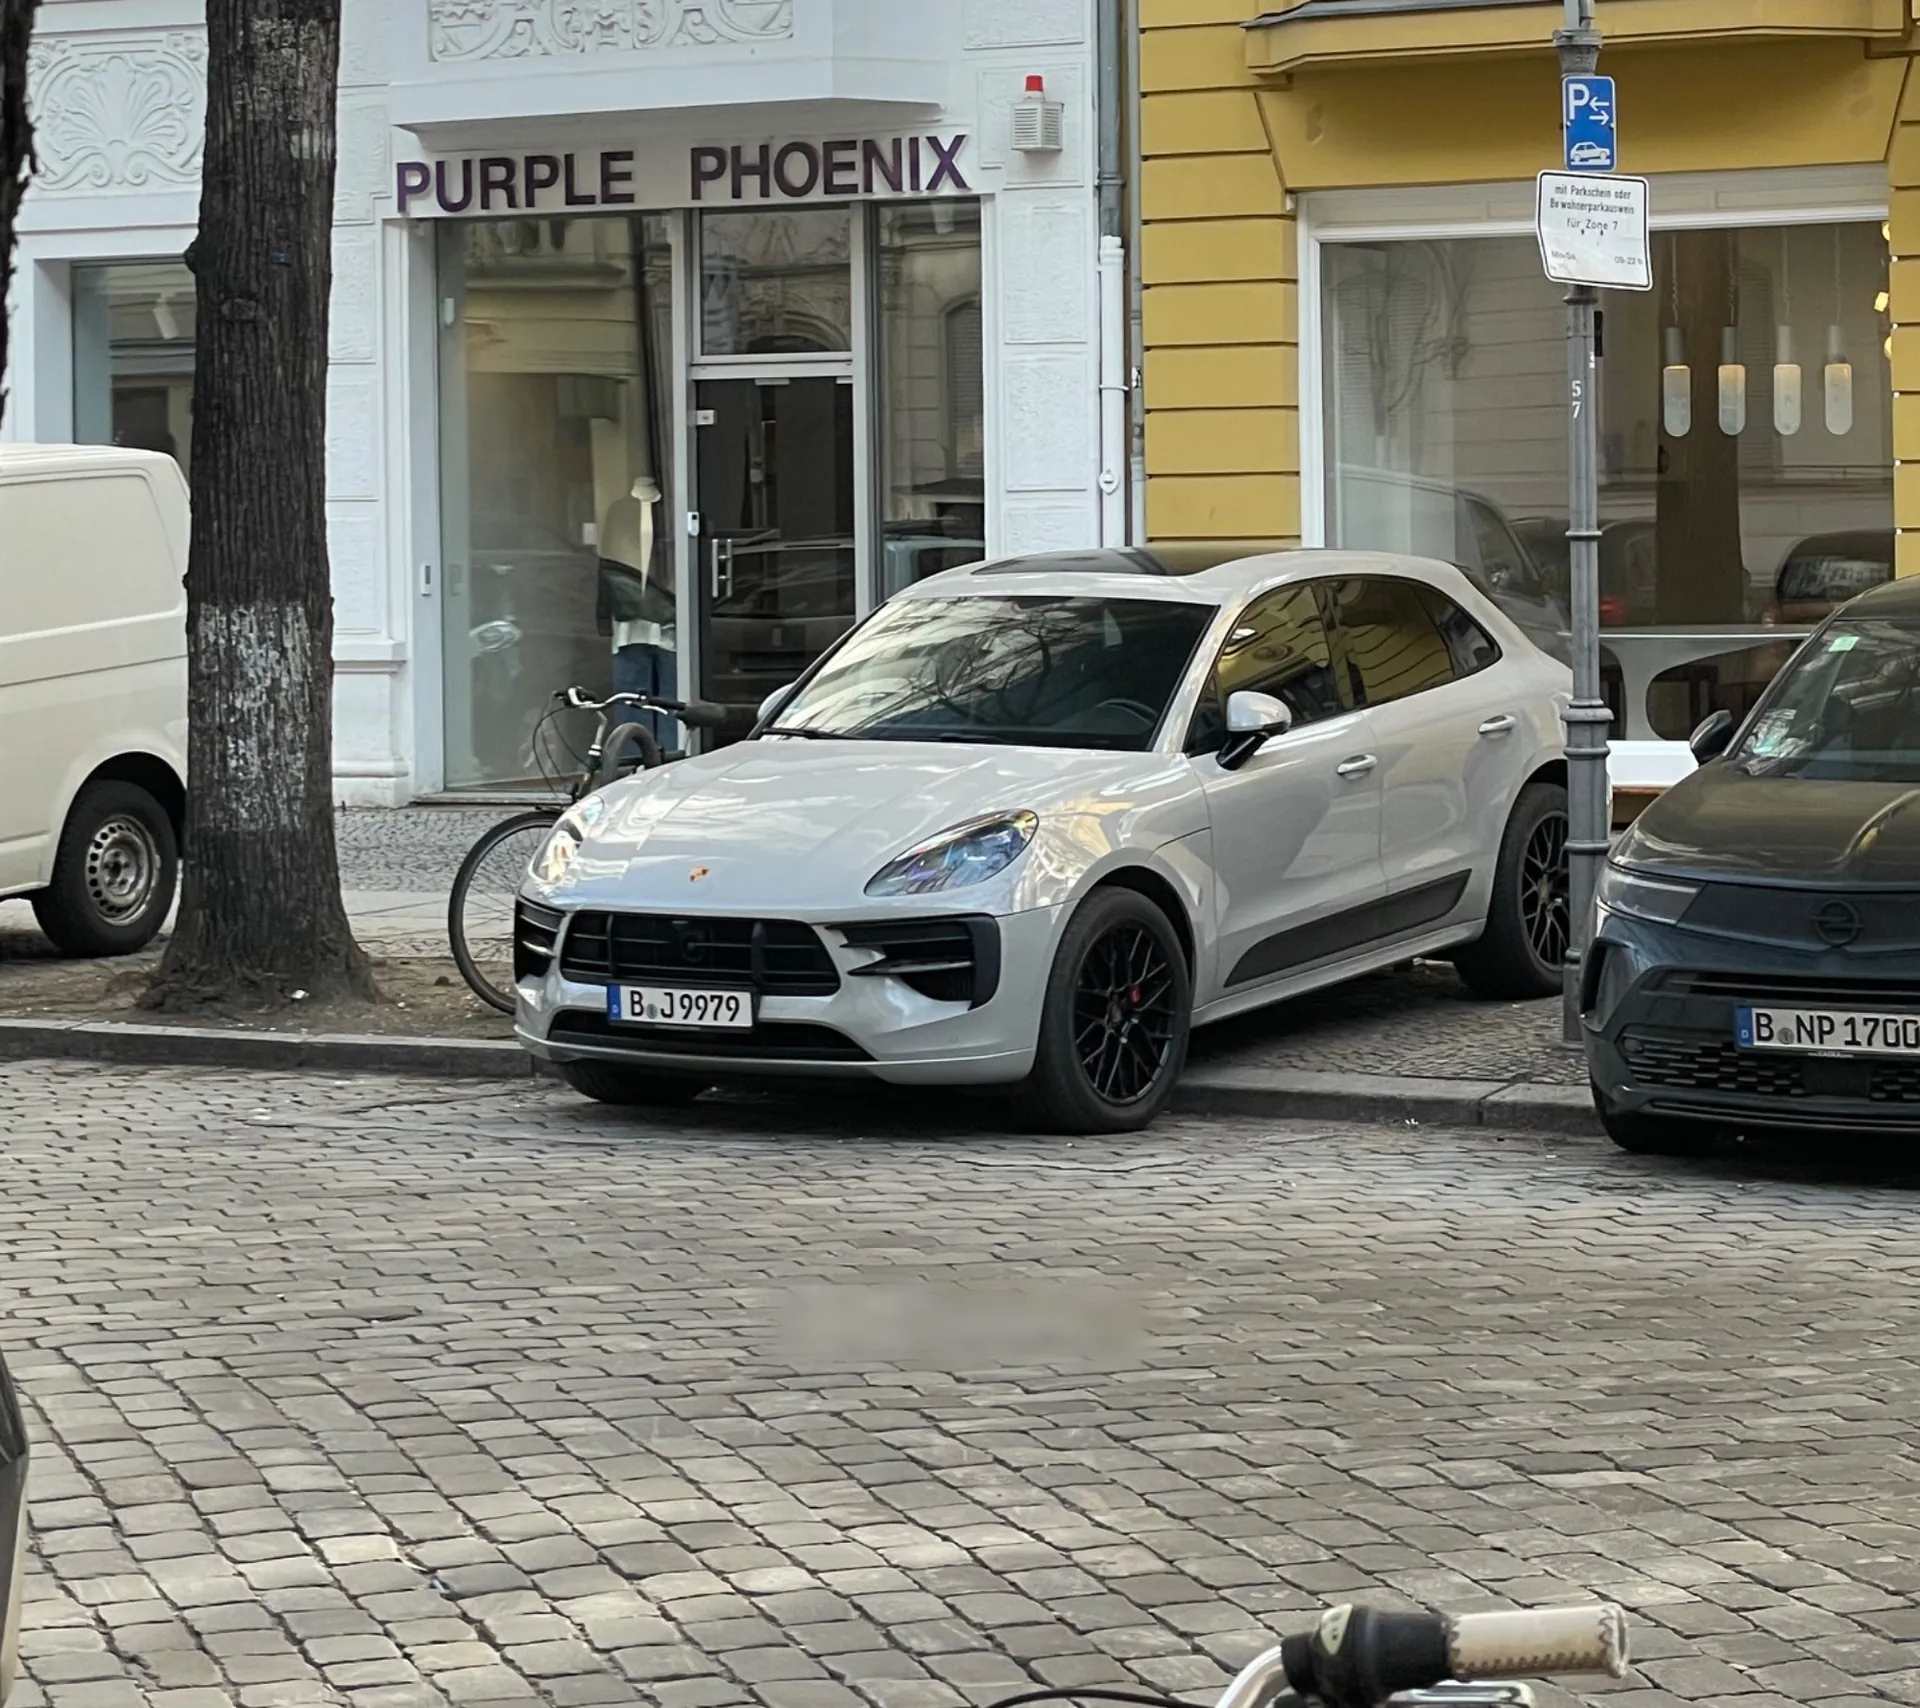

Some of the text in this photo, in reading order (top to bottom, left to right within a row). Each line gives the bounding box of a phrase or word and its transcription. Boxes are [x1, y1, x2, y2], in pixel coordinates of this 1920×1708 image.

[1568, 83, 1590, 120] P
[396, 134, 970, 216] PURPLE PHOENIX
[1555, 185, 1632, 200] mit Parkschein oder
[1566, 217, 1619, 231] für Zone 7
[629, 989, 645, 1017] B
[1755, 1012, 1775, 1042] B
[1795, 1014, 1836, 1045] NP
[1843, 1016, 1920, 1049] 1700
